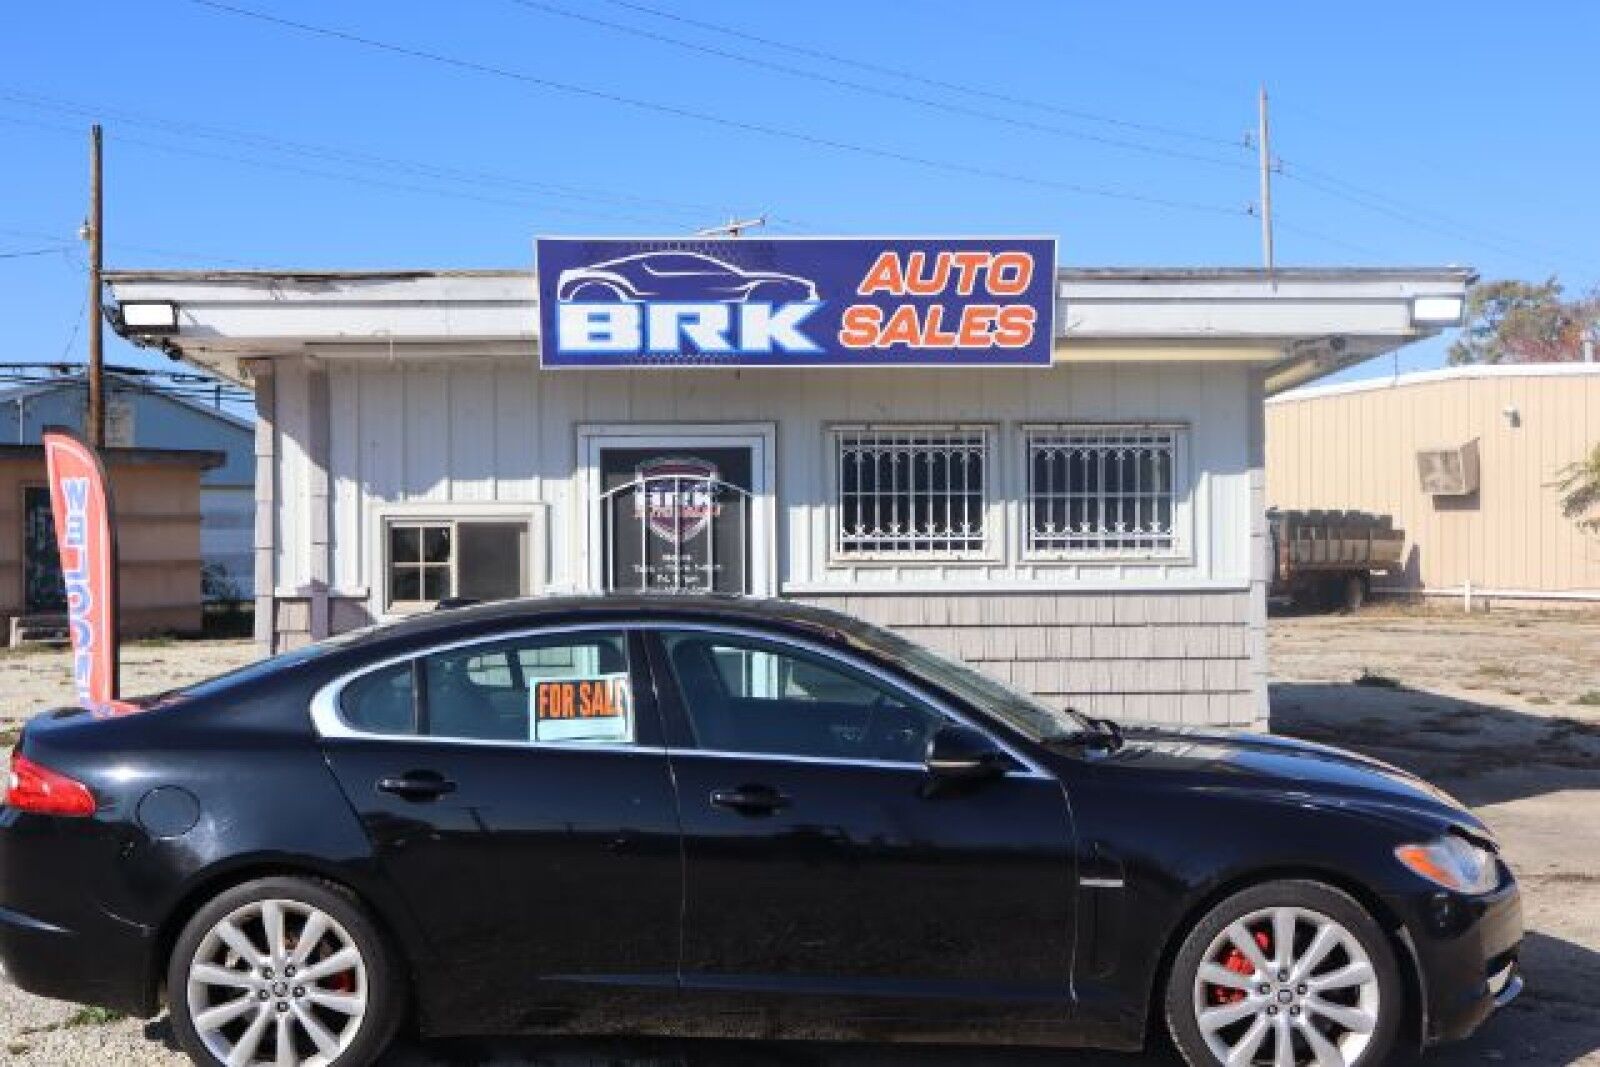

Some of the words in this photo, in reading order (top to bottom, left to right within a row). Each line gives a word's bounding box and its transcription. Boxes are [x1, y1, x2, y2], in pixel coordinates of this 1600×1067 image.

[858, 250, 1034, 296] AUTO
[557, 299, 822, 353] BRK
[837, 303, 1038, 349] SALES
[539, 682, 575, 718] FOR
